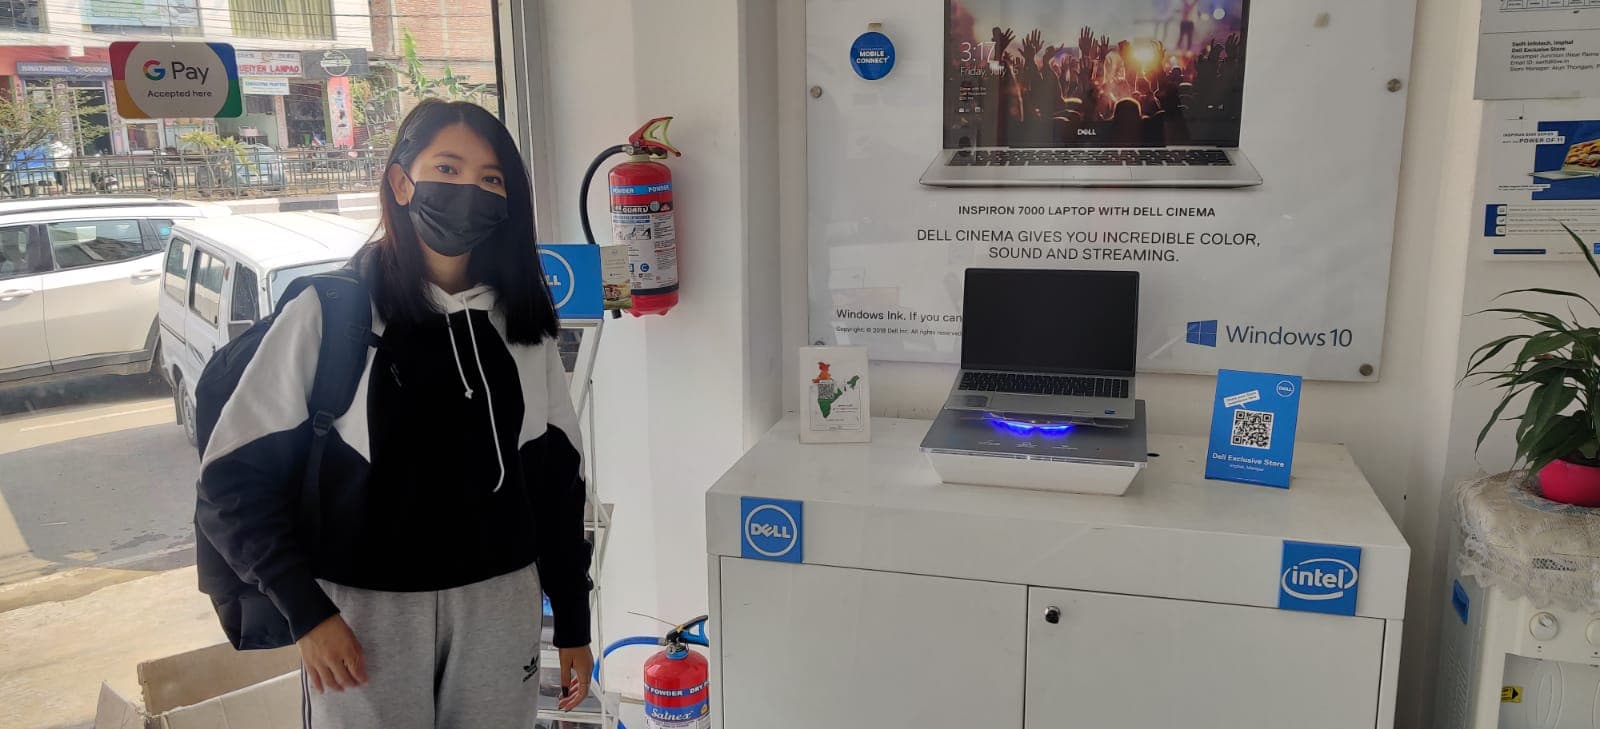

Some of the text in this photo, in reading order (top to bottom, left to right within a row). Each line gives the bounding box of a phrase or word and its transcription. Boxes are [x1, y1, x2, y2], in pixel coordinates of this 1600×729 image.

[960, 41, 997, 63] 3:17
[143, 59, 209, 86] G Pay
[960, 65, 987, 78] Friday,
[990, 65, 1007, 78] July
[148, 89, 190, 99] Accepted
[1077, 128, 1097, 136] DELL
[958, 205, 1216, 217] INSPIRON 7000 LAPTOP WITH DELL CINEMA
[917, 229, 1261, 247] DELL CINEMA GIVES YOU INCREDIBLE COLOR,
[988, 246, 1180, 262] SOUND AND STREAMING.
[836, 309, 962, 323] Windows Ink. If you can
[1226, 325, 1353, 348] Windows 10
[1212, 452, 1285, 468] Dell Exclusive Store
[750, 522, 791, 539] DELL
[1291, 565, 1345, 589] intel
[650, 687, 683, 697] POWDER
[689, 685, 704, 694] DRY
